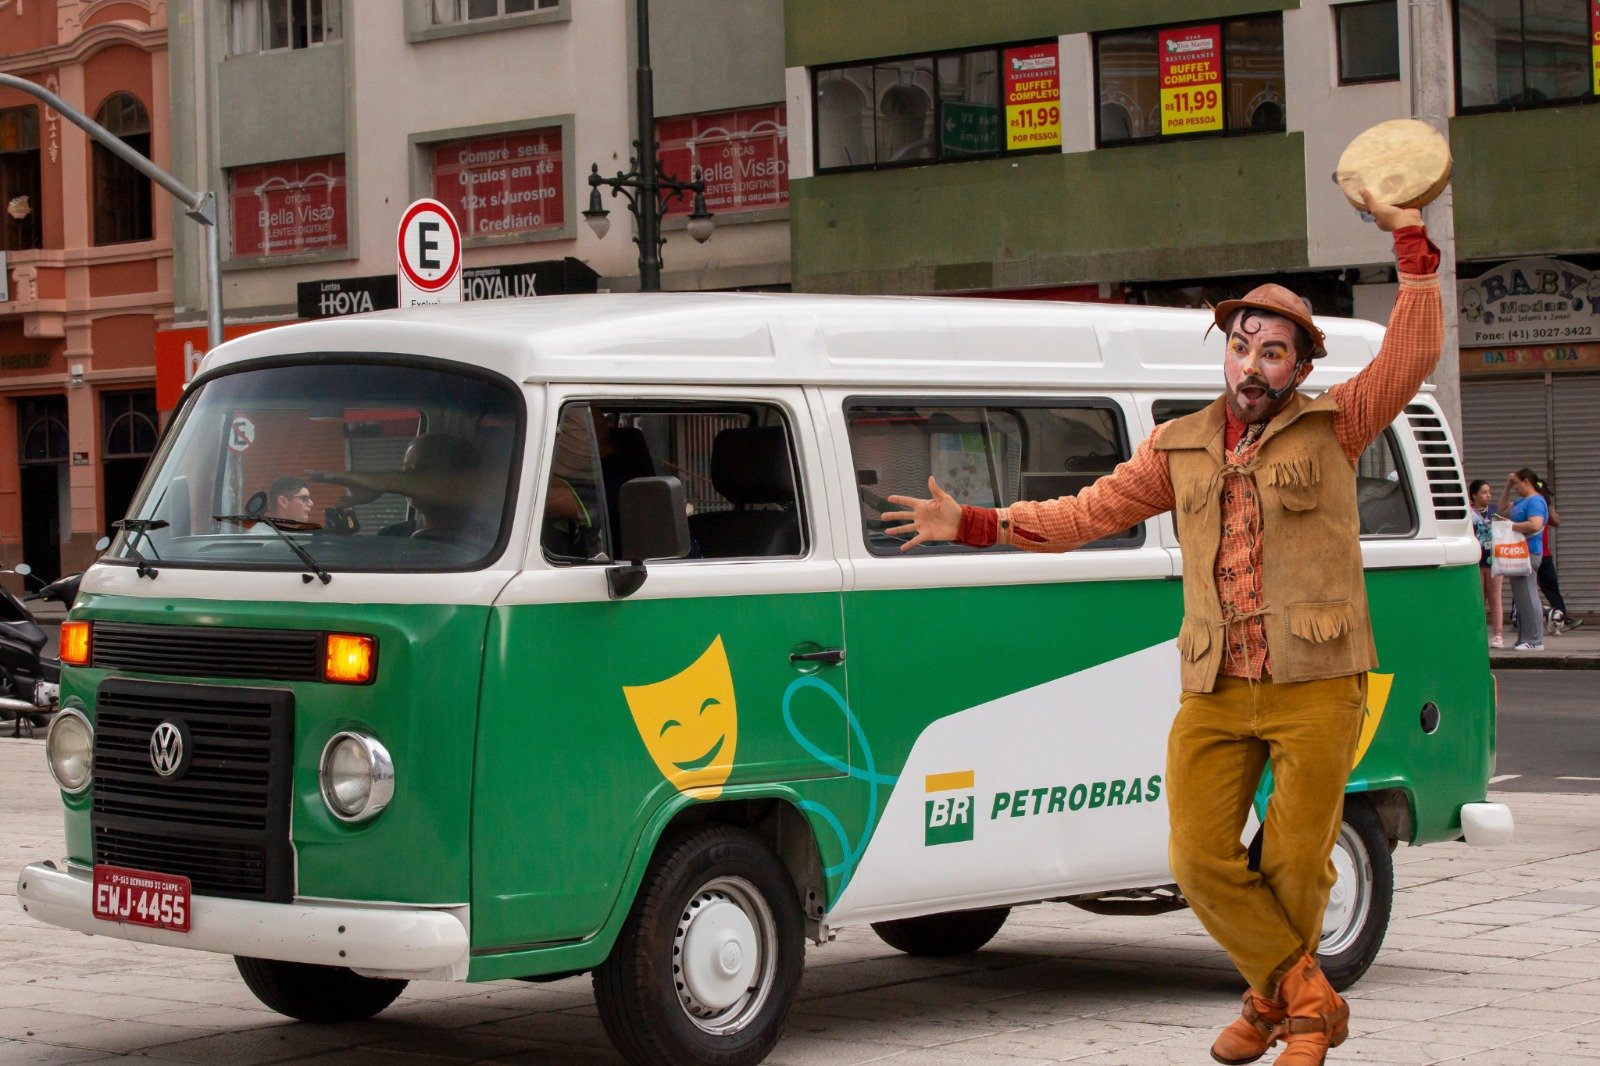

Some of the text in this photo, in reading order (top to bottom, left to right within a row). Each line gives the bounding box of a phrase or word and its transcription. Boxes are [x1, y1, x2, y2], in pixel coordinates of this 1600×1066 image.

[1165, 52, 1215, 62] RESTAURANTE
[1011, 70, 1057, 80] RESTAURANTE
[1170, 61, 1211, 75] BUFFET
[1015, 79, 1053, 92] BUFFET
[1164, 71, 1218, 85] COMPLETO
[1009, 88, 1060, 102] COMPLETO
[1168, 116, 1216, 128] POR PESSOA
[1013, 131, 1058, 142] POR PESSOA
[459, 143, 549, 165] Compre seus
[511, 165, 532, 178] em
[690, 157, 786, 183] Bella Visão
[703, 179, 777, 195] ENTES DIGITAIS
[461, 194, 487, 209] 12x
[258, 203, 335, 228] Bella Visão
[479, 212, 541, 232] Crediário
[419, 222, 441, 270] E
[462, 273, 537, 301] HOYALUX
[1481, 268, 1588, 304] BABY
[318, 290, 374, 315] HOYA
[1500, 300, 1568, 314] Modas
[1475, 326, 1592, 341] Fone: (41) 3027-3422
[990, 774, 1162, 820] PETROBRAS
[929, 795, 972, 828] BR
[161, 882, 179, 892] CAMPO
